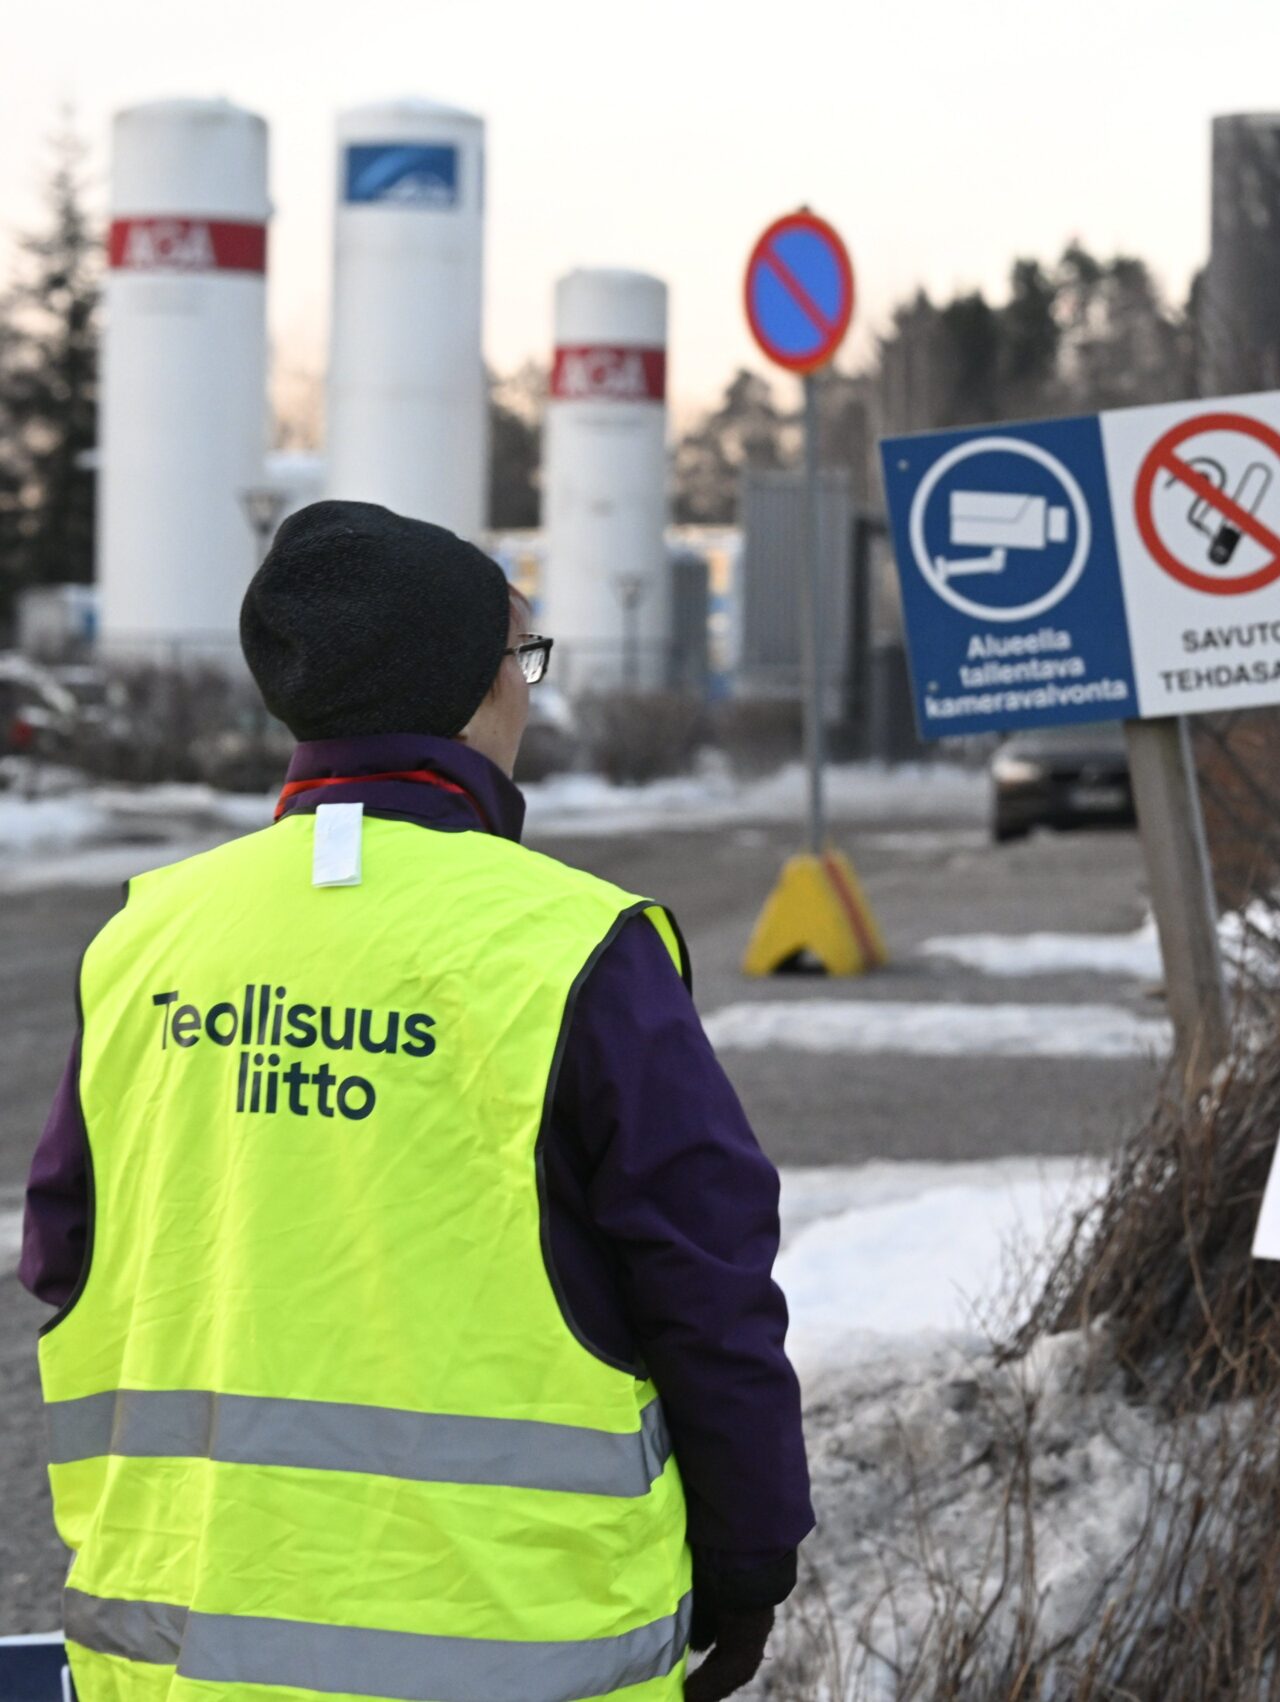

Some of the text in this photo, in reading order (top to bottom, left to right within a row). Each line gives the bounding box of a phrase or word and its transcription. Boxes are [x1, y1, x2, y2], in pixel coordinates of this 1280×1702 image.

[967, 628, 1072, 660] Alueella
[959, 655, 1085, 689] tallentava
[925, 676, 1128, 719] kameravalvonta
[152, 984, 437, 1057] Teollisuus
[236, 1051, 376, 1121] liitto
